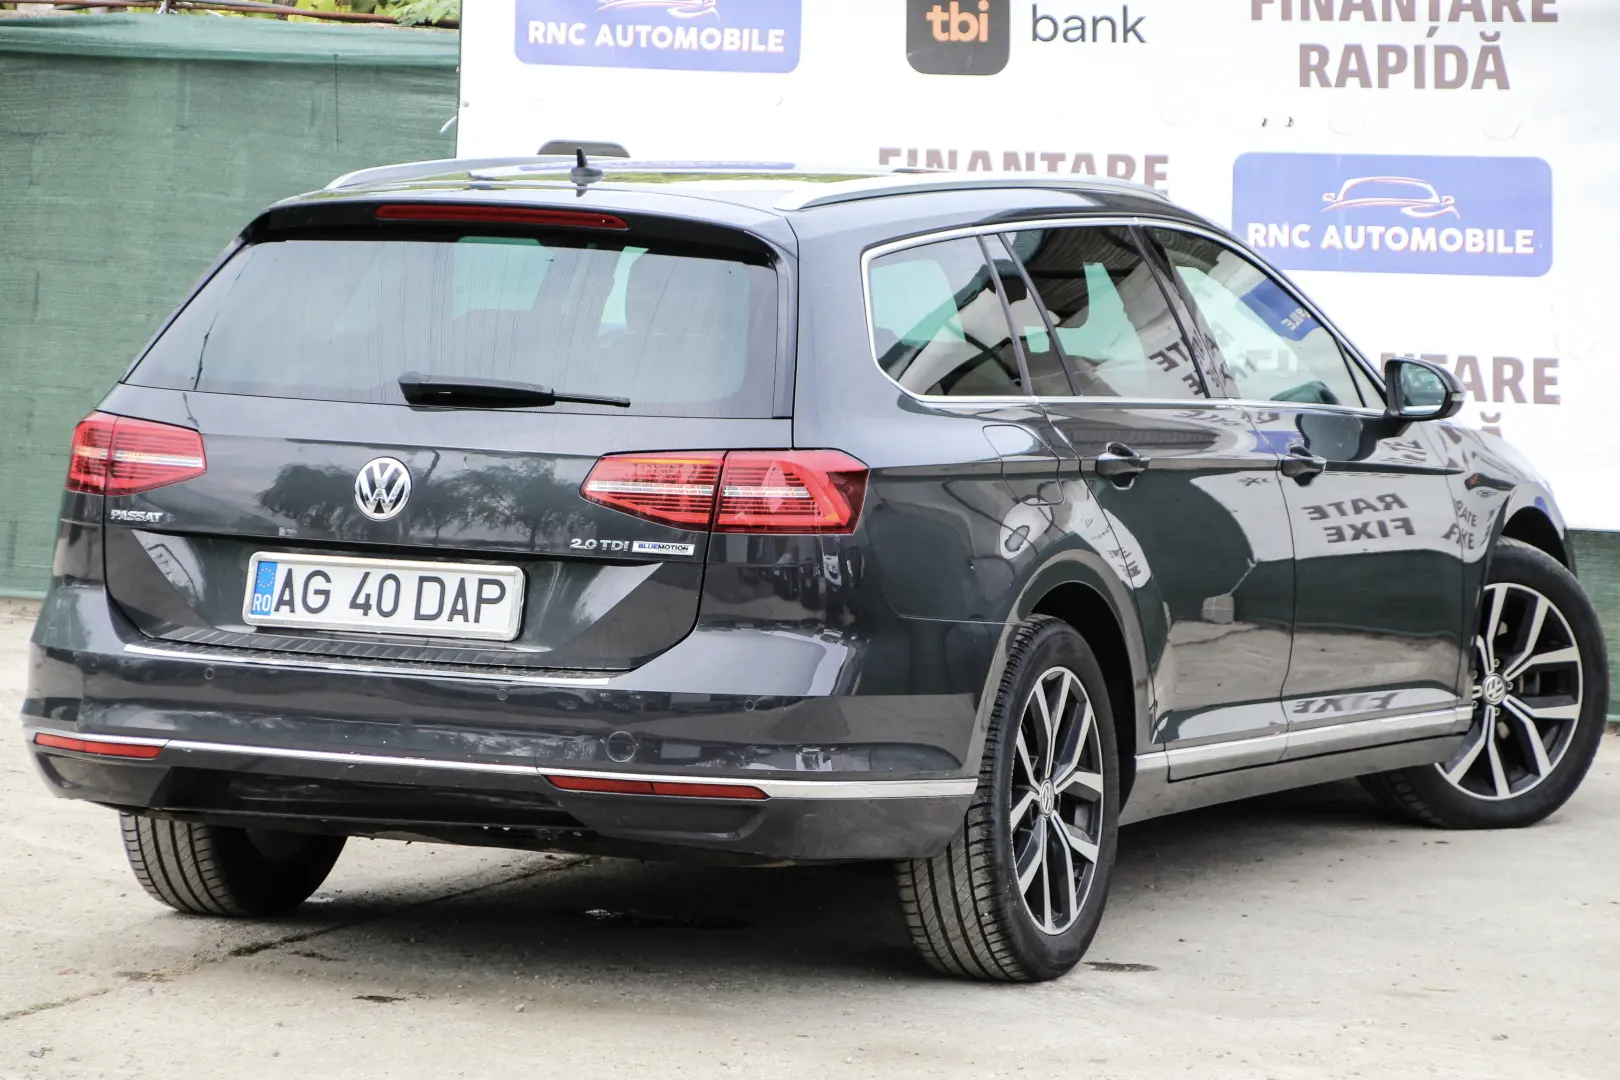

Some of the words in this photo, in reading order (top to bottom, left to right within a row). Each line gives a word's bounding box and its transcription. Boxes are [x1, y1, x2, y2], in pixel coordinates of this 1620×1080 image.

[528, 20, 586, 45] RNC
[594, 24, 786, 52] AUTOMOBILE
[925, 0, 991, 42] tbi
[1031, 4, 1148, 43] bank
[1247, 222, 1312, 249] RNC
[1320, 225, 1536, 254] AUTOMOBILE
[110, 509, 163, 522] PASSAT
[569, 538, 598, 550] 2.0
[600, 539, 630, 552] TDI
[638, 543, 689, 552] BLUEMOTION
[252, 593, 272, 612] RO
[273, 568, 332, 614] AG
[349, 571, 401, 618] 40
[414, 576, 507, 624] DAP
